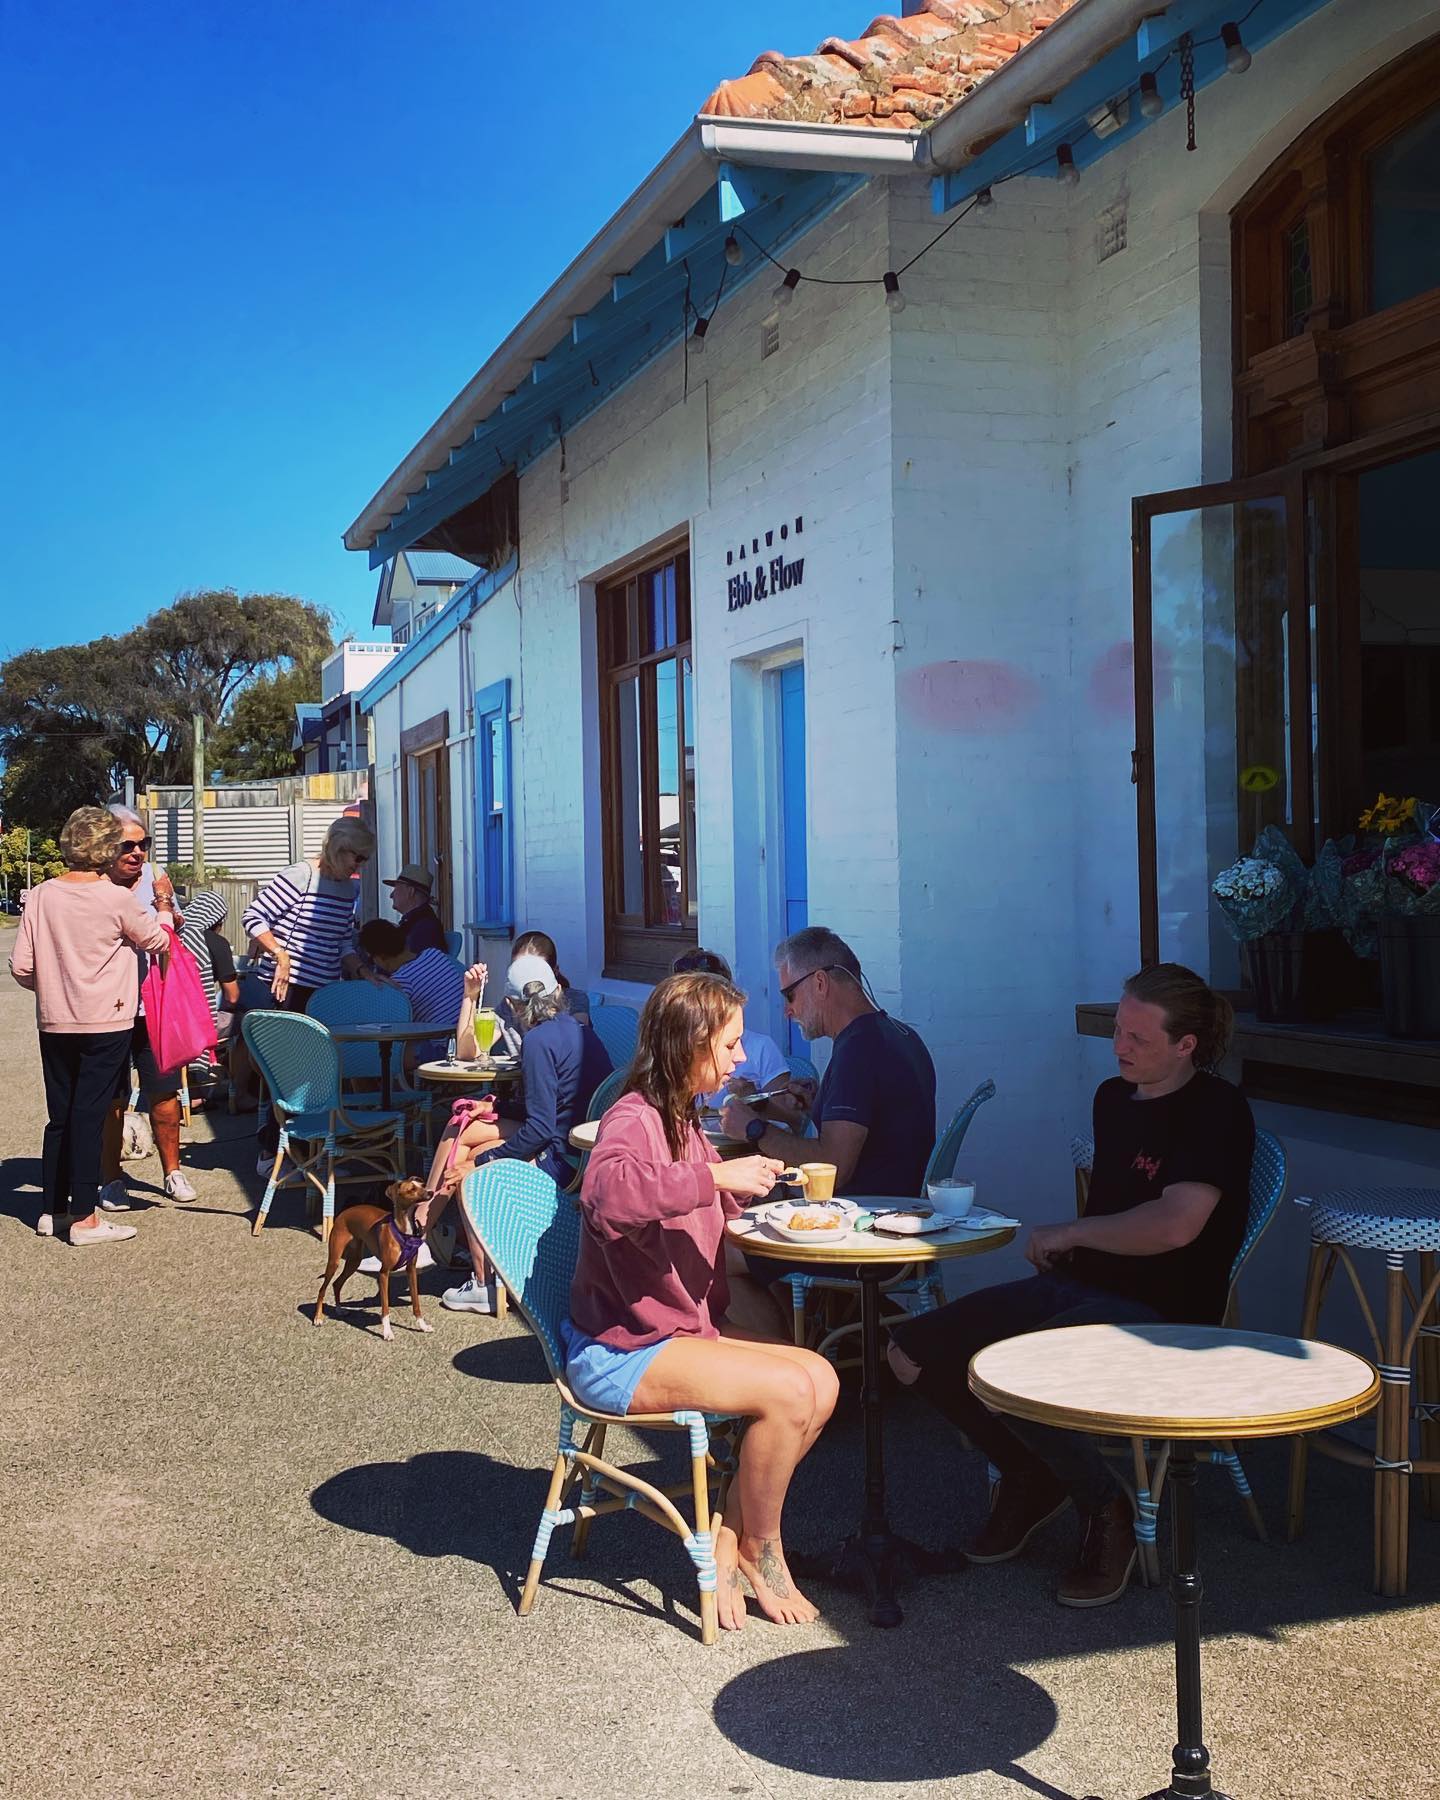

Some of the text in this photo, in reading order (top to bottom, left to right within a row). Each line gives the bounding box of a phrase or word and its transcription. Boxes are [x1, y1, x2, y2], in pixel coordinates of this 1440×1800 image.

[726, 554, 805, 612] Ebb & Flow
